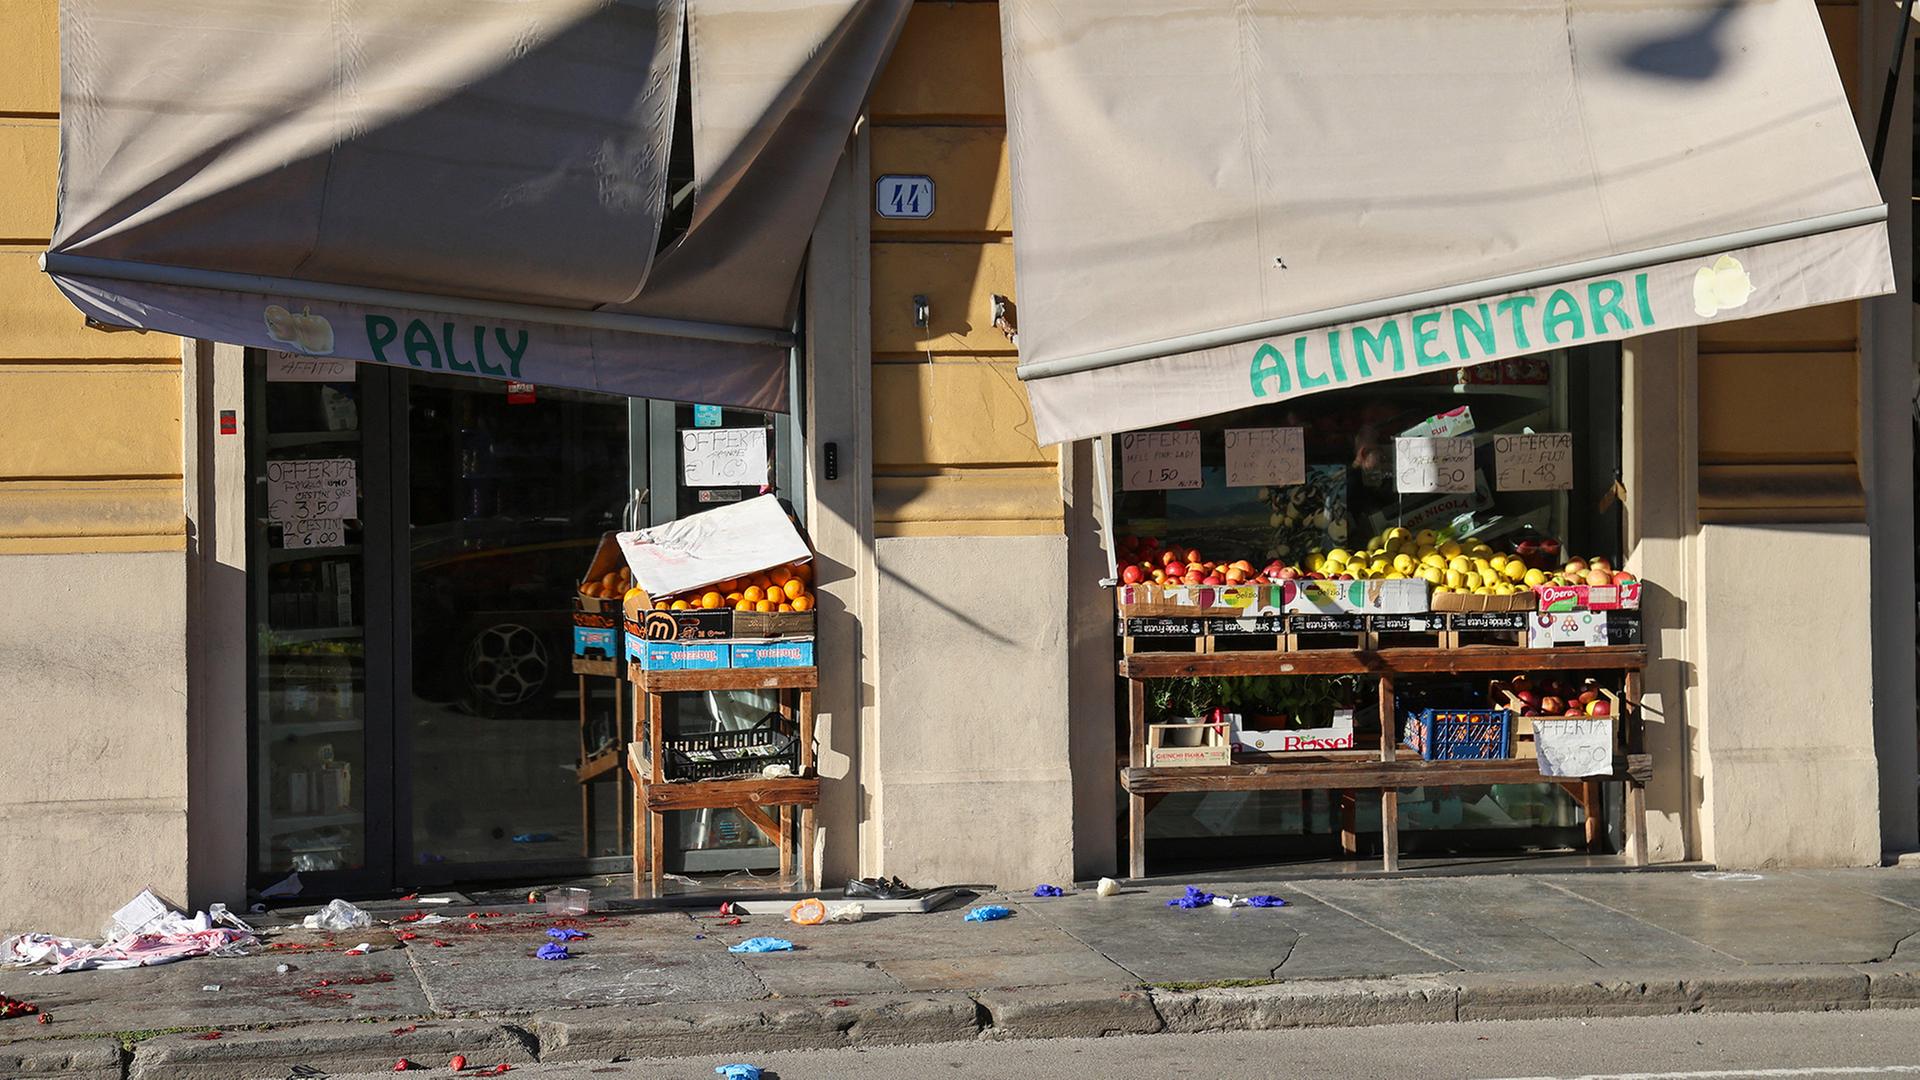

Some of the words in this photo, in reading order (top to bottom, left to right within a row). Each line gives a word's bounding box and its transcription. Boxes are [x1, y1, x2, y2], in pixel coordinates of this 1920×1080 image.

[1250, 273, 1656, 398] ALIMENTARI
[365, 314, 529, 378] PALLY
[1431, 425, 1448, 436] FUJI
[683, 429, 765, 452] OFFERTA
[1123, 432, 1200, 449] OFFERTA
[1495, 434, 1571, 453] OFFERTA
[268, 460, 356, 482] OFFERTA
[1148, 467, 1179, 483] 1.50
[1422, 467, 1465, 488] 1.50
[1521, 463, 1555, 484] 1.48
[1424, 500, 1468, 518] NICOLA
[303, 532, 337, 545] 6.00
[1543, 588, 1574, 602] Opera
[1143, 624, 1165, 634] Frutta
[1305, 621, 1327, 630] Frutta
[1386, 620, 1408, 629] Frutta
[1467, 618, 1488, 627] Frutta
